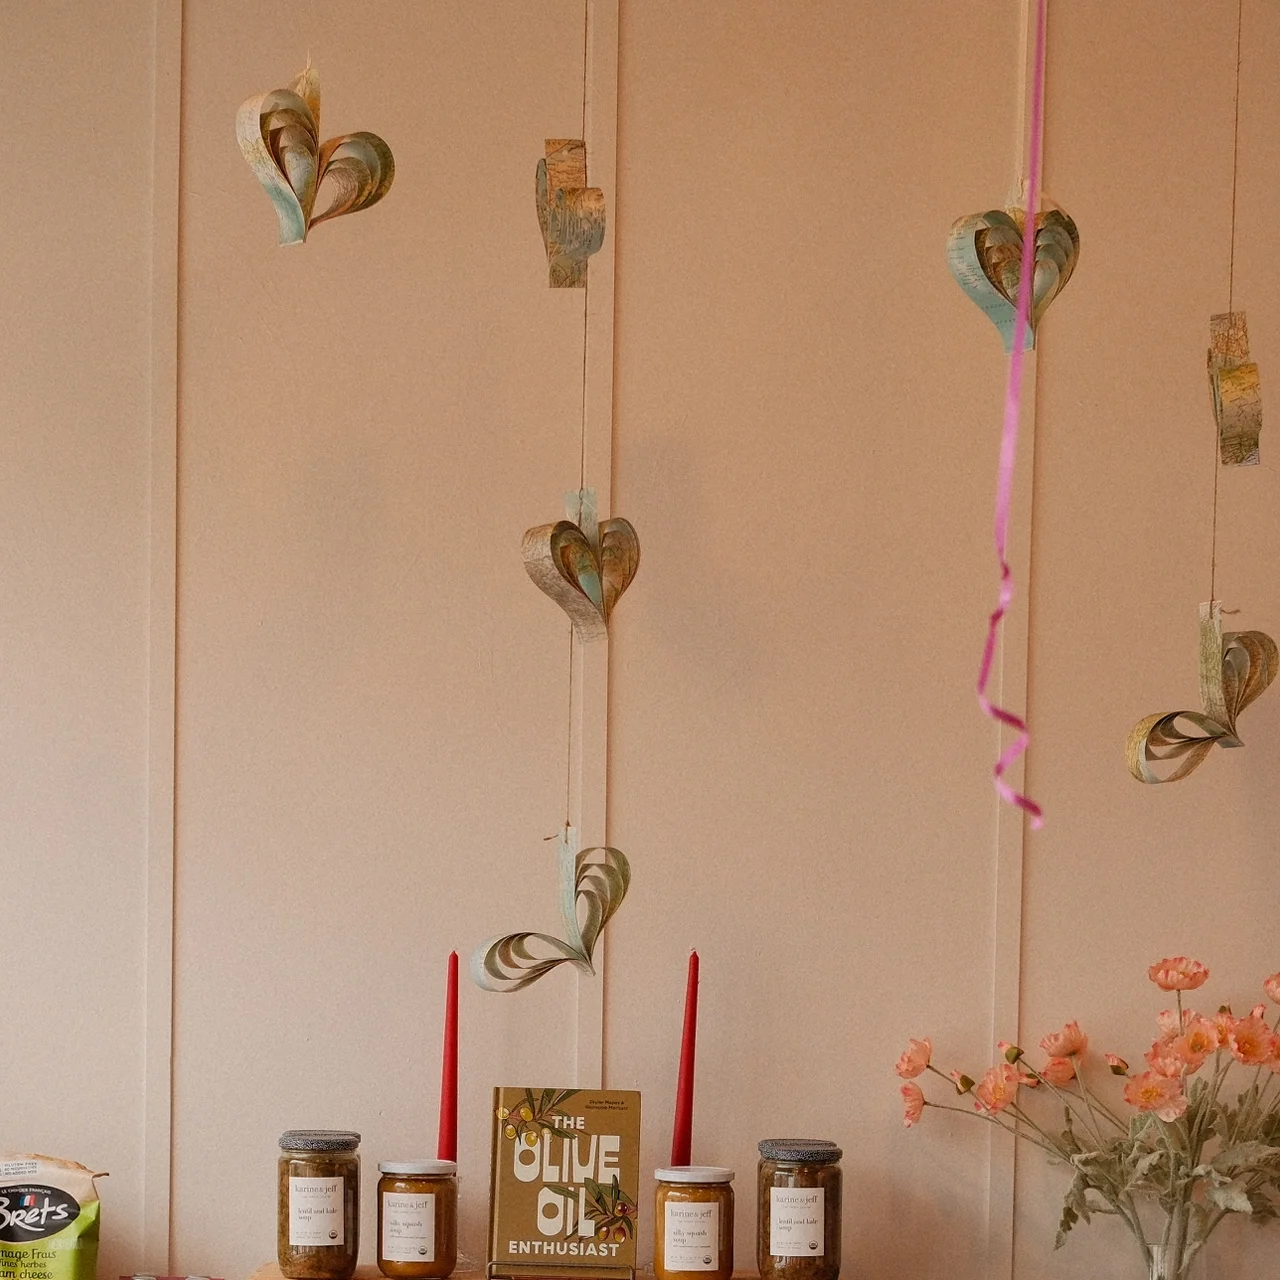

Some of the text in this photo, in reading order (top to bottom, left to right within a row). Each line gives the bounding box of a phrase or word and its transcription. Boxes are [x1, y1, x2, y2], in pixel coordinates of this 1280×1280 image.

[552, 1116, 585, 1129] THE
[513, 1132, 620, 1184] OLIVE
[294, 1184, 338, 1195] karine jeff
[387, 1200, 429, 1210] karine jeff
[775, 1195, 818, 1206] karine jeff
[537, 1186, 595, 1237] OIL
[670, 1209, 712, 1220] karine jeff
[32, 1248, 56, 1259] Frais
[508, 1240, 620, 1257] ENTHUSIAST
[20, 1260, 47, 1268] herbes
[20, 1269, 54, 1280] cheese
